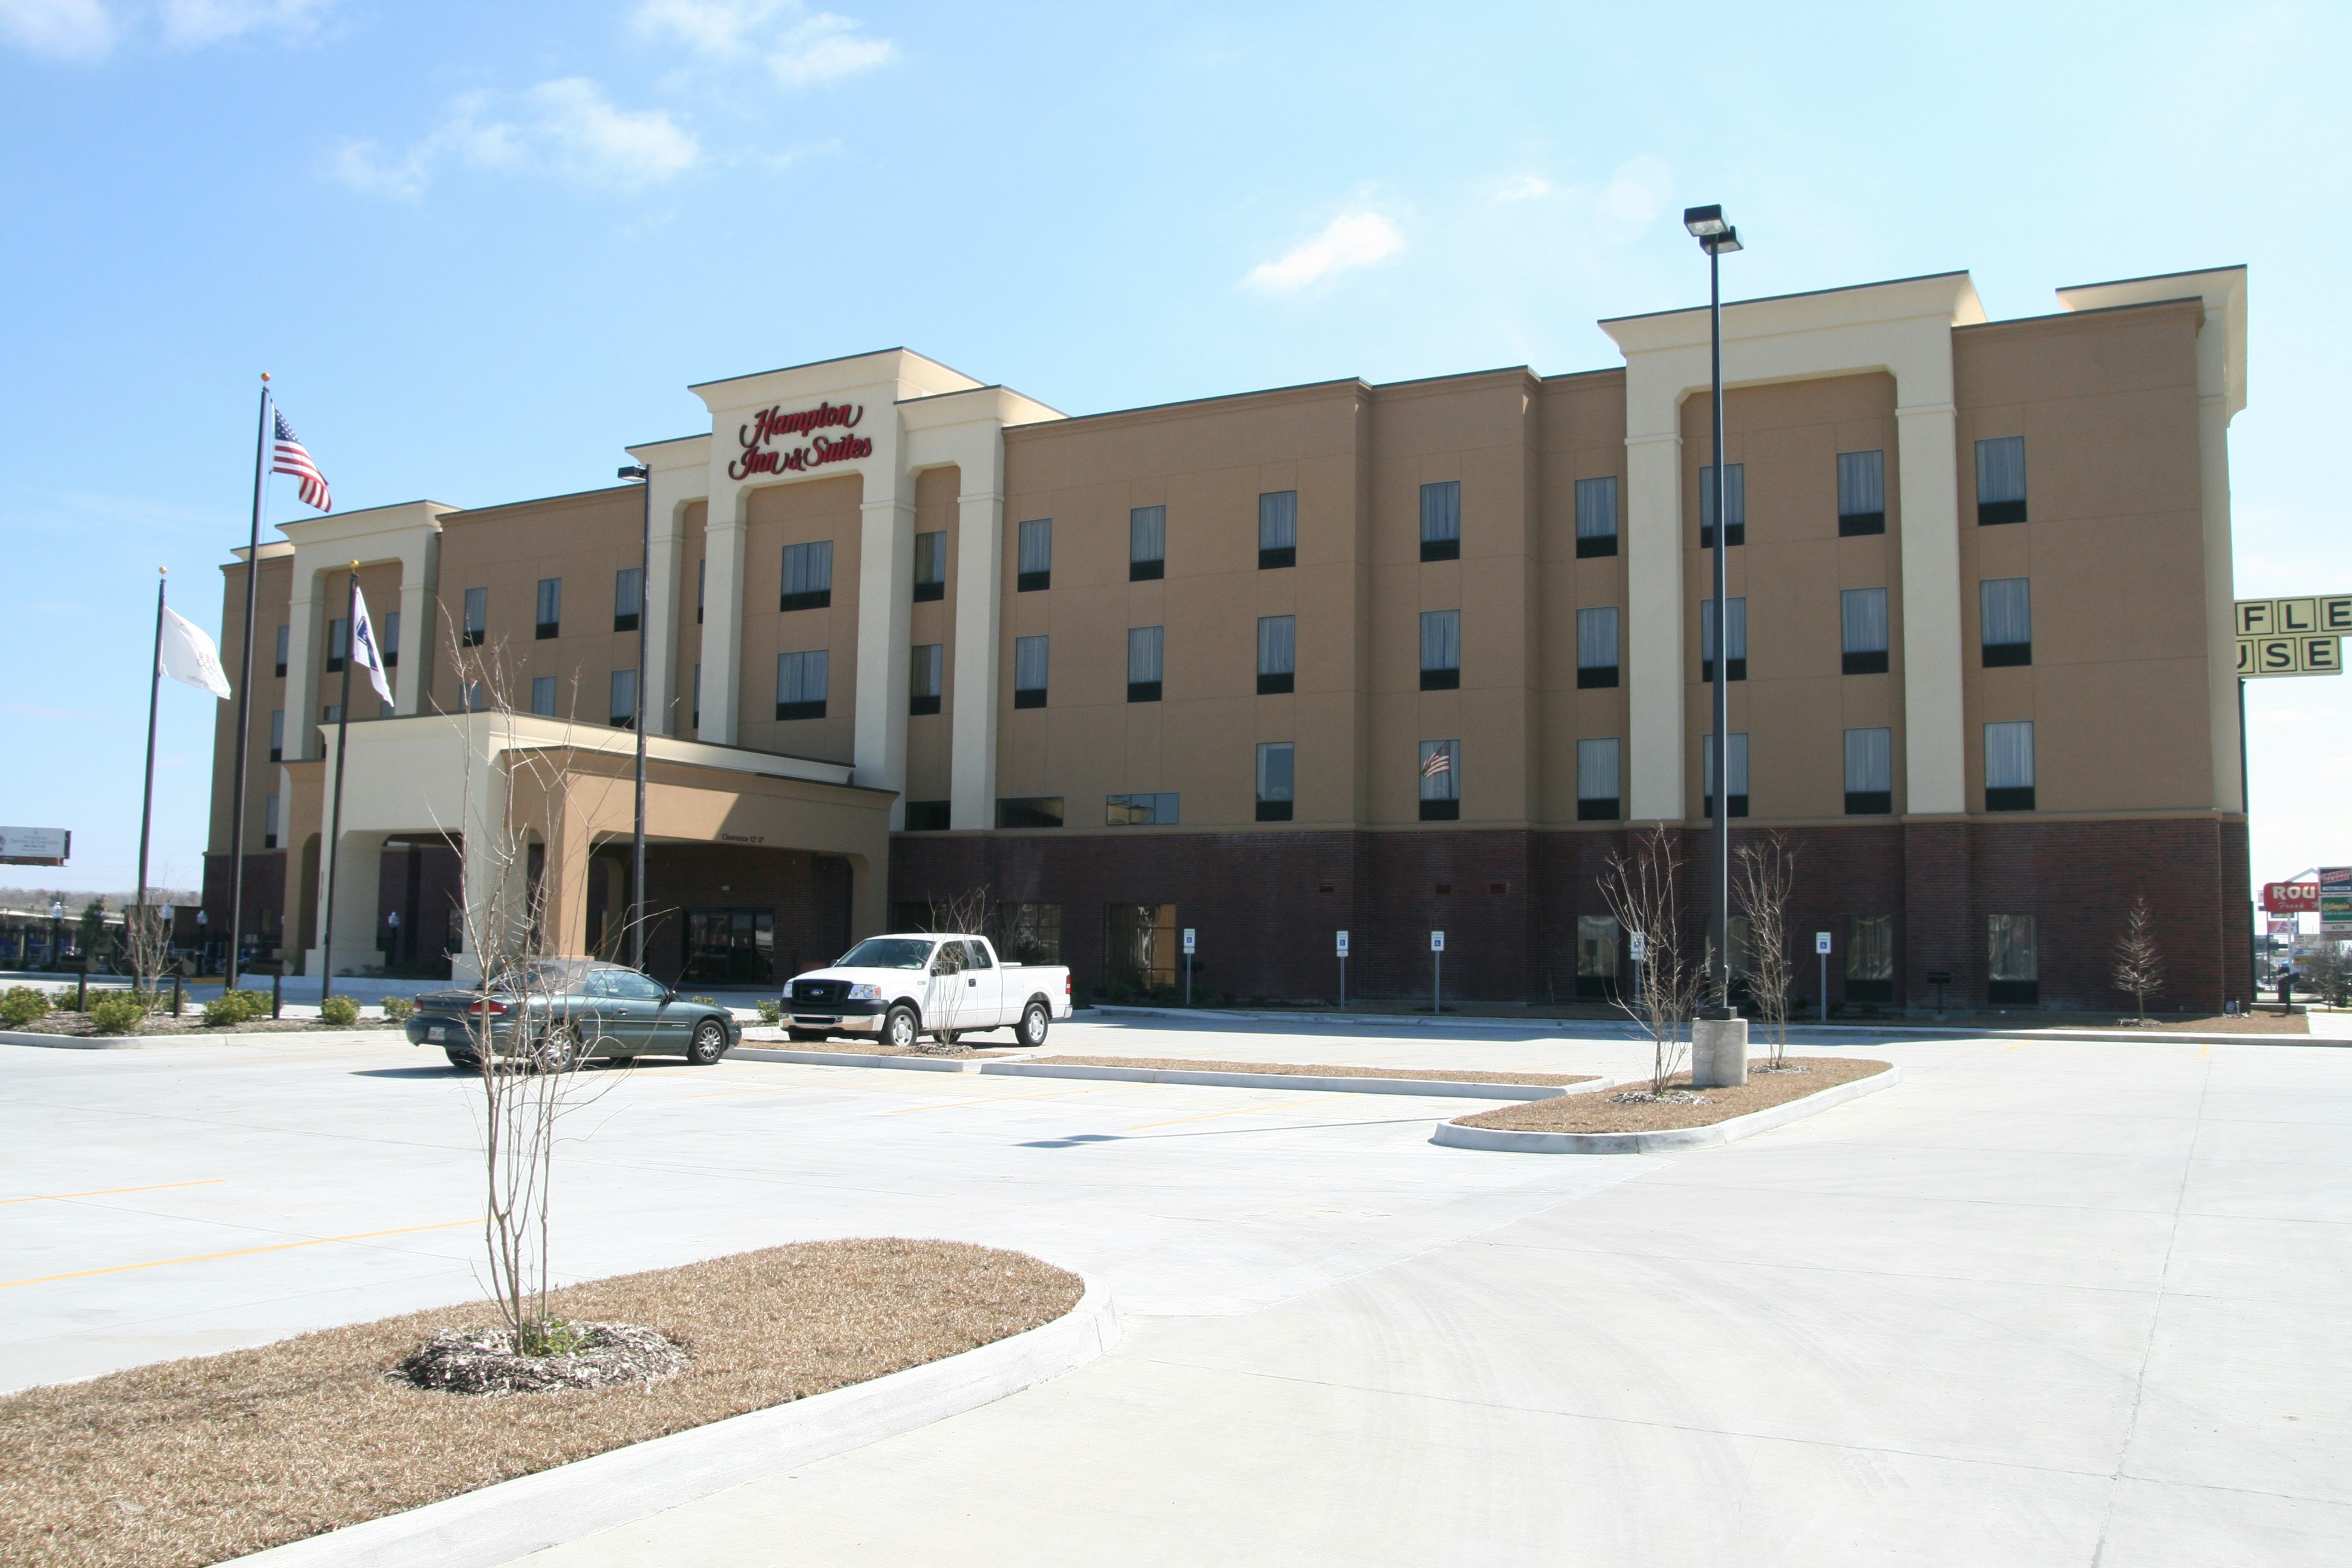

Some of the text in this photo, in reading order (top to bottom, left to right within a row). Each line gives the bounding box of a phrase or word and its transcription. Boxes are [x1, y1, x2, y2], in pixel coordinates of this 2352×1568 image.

[739, 402, 863, 448] Hampton
[728, 433, 872, 480] Inn & Suites
[722, 833, 749, 843] Clearance
[2273, 886, 2315, 900] ROU
